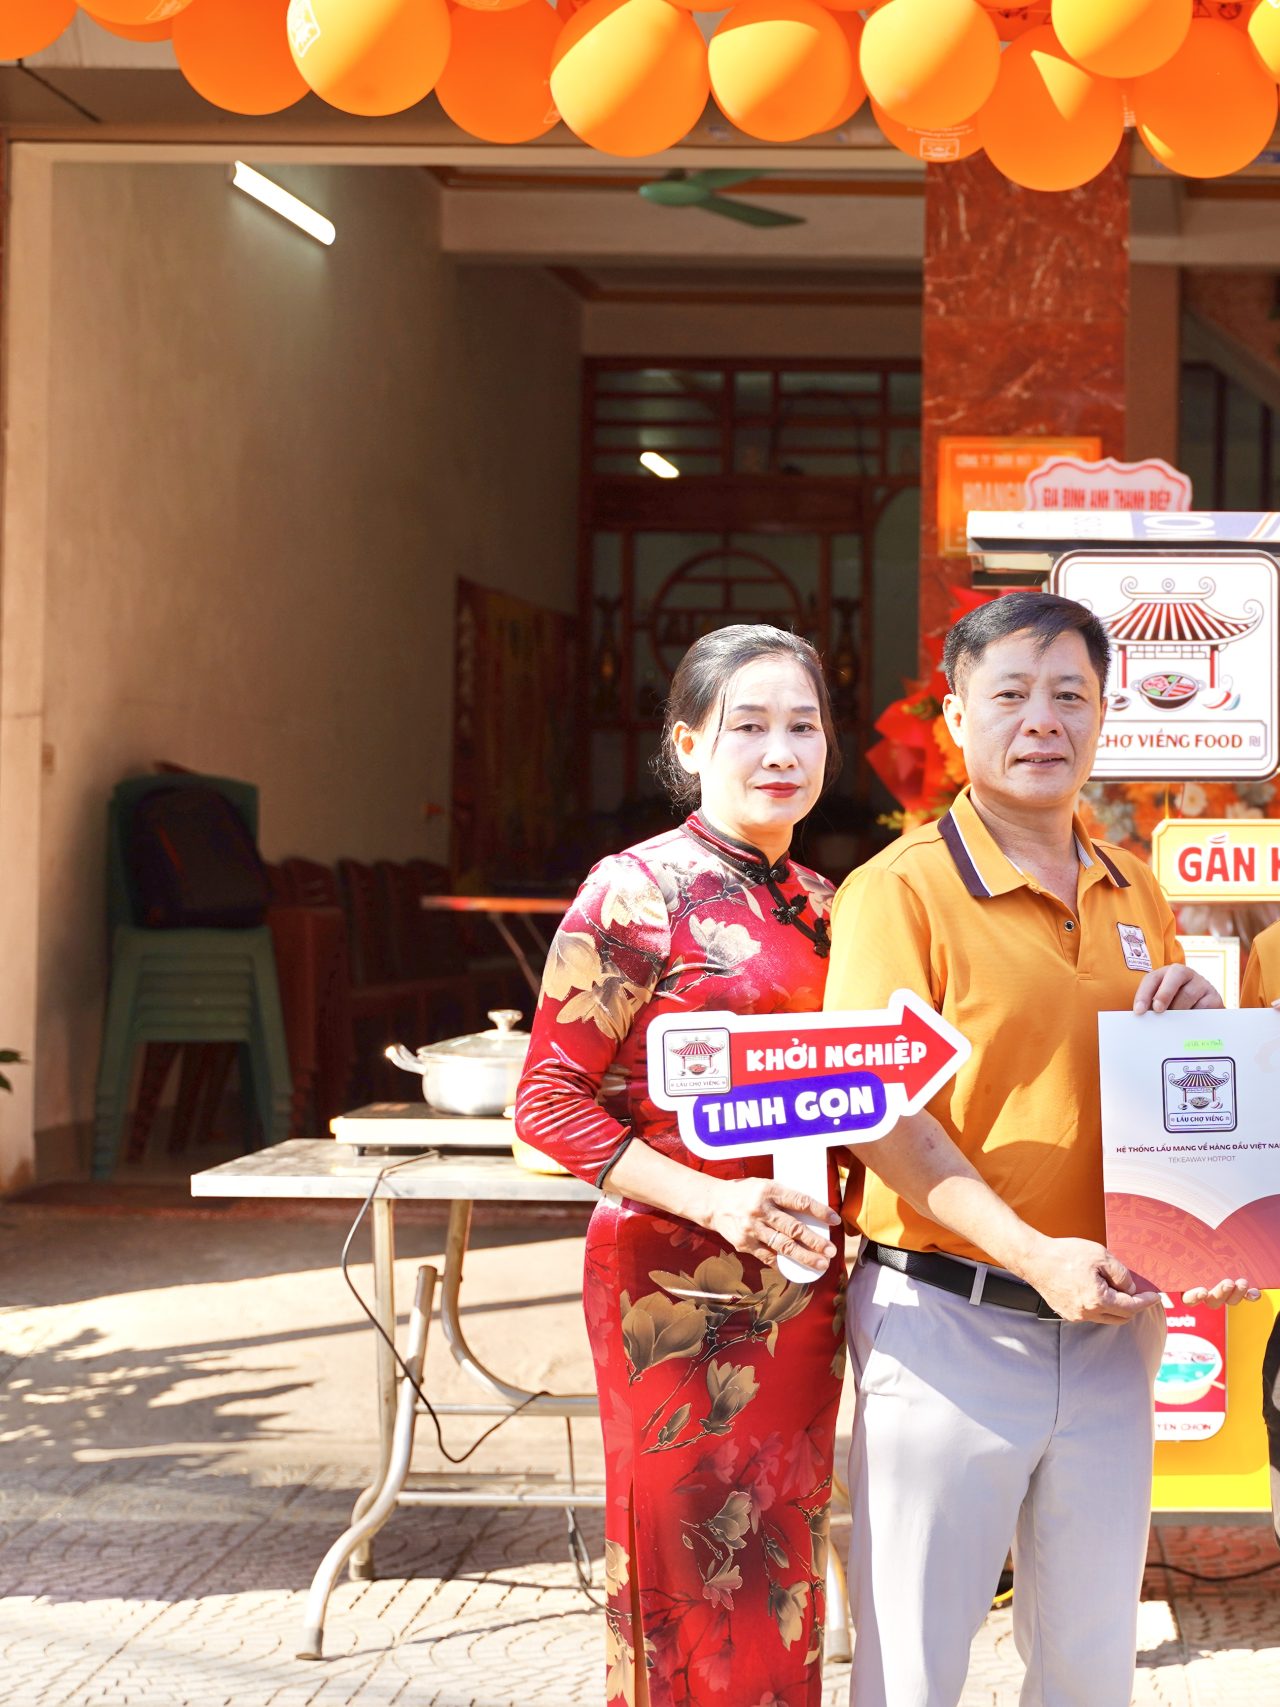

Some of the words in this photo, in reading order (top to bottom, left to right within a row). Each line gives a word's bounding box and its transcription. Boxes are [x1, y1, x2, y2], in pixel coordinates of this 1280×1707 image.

[1194, 734, 1243, 749] FOOD
[1177, 834, 1255, 882] GẮN
[746, 1037, 817, 1072] KHỞI
[824, 1035, 928, 1071] NGHIỆP
[702, 1096, 787, 1133] TINH
[795, 1085, 875, 1126] GỌN
[1207, 1155, 1237, 1163] HOTPOT
[1209, 1142, 1231, 1151] HÀNG
